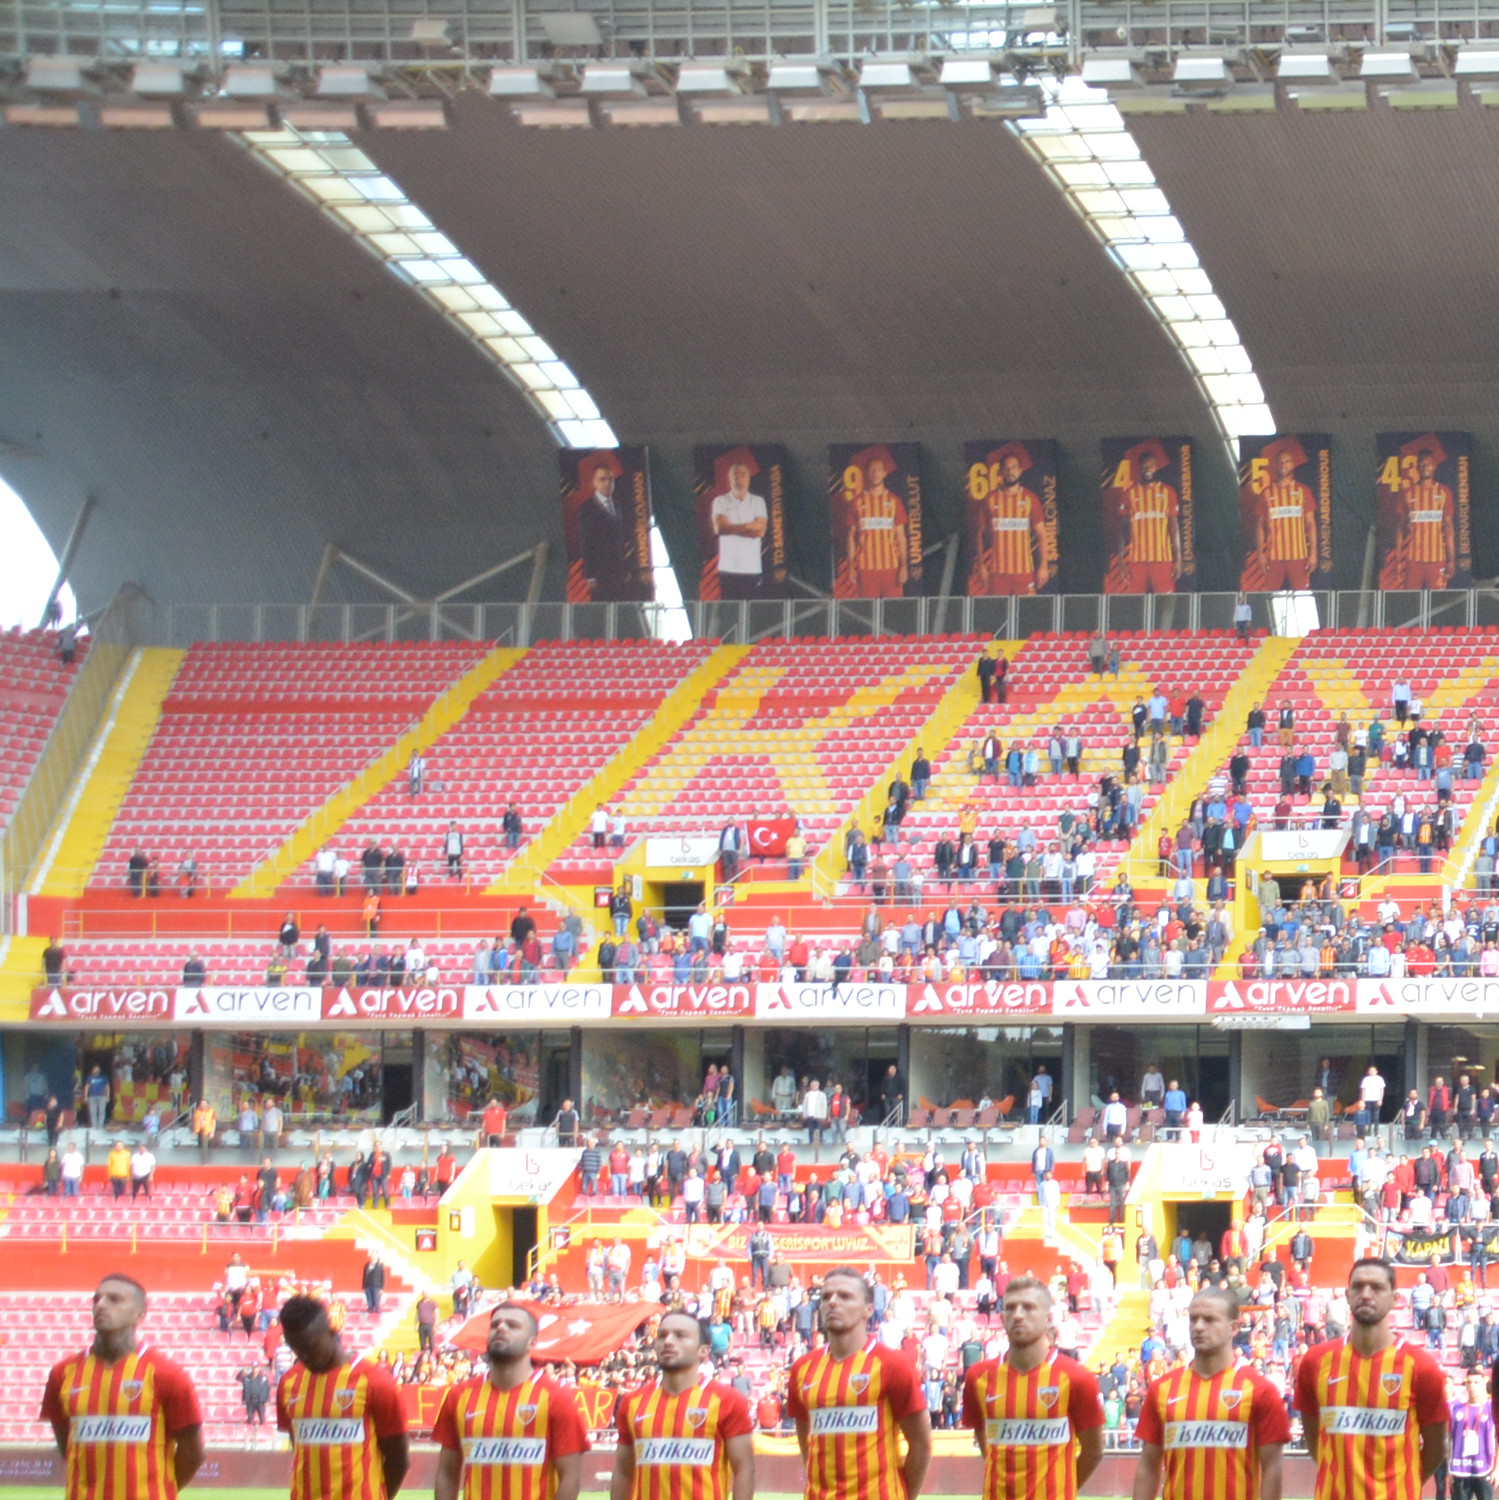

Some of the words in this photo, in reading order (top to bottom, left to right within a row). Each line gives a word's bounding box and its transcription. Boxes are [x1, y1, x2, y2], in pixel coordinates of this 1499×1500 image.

[844, 465, 863, 501] 9
[1113, 459, 1133, 491] 4
[1252, 457, 1270, 495] 5
[1382, 455, 1420, 492] 43
[70, 988, 169, 1014] arven
[216, 990, 312, 1012] arven
[360, 988, 457, 1013] arven
[506, 987, 602, 1009] arven
[650, 985, 750, 1009] arven
[799, 985, 896, 1008] arven
[945, 984, 1047, 1008] arven
[1097, 983, 1196, 1005] arven
[1247, 981, 1350, 1005] arven
[1404, 1237, 1450, 1257] KAPALI
[80, 1419, 149, 1439] istikbal
[298, 1421, 361, 1440] istikbal
[813, 1410, 876, 1429] istikbal
[1000, 1420, 1066, 1441] istikbal
[1337, 1410, 1404, 1431] istikbal
[1179, 1422, 1246, 1443] istikbal
[474, 1441, 544, 1459] istikbal
[644, 1442, 712, 1460] istikbal
